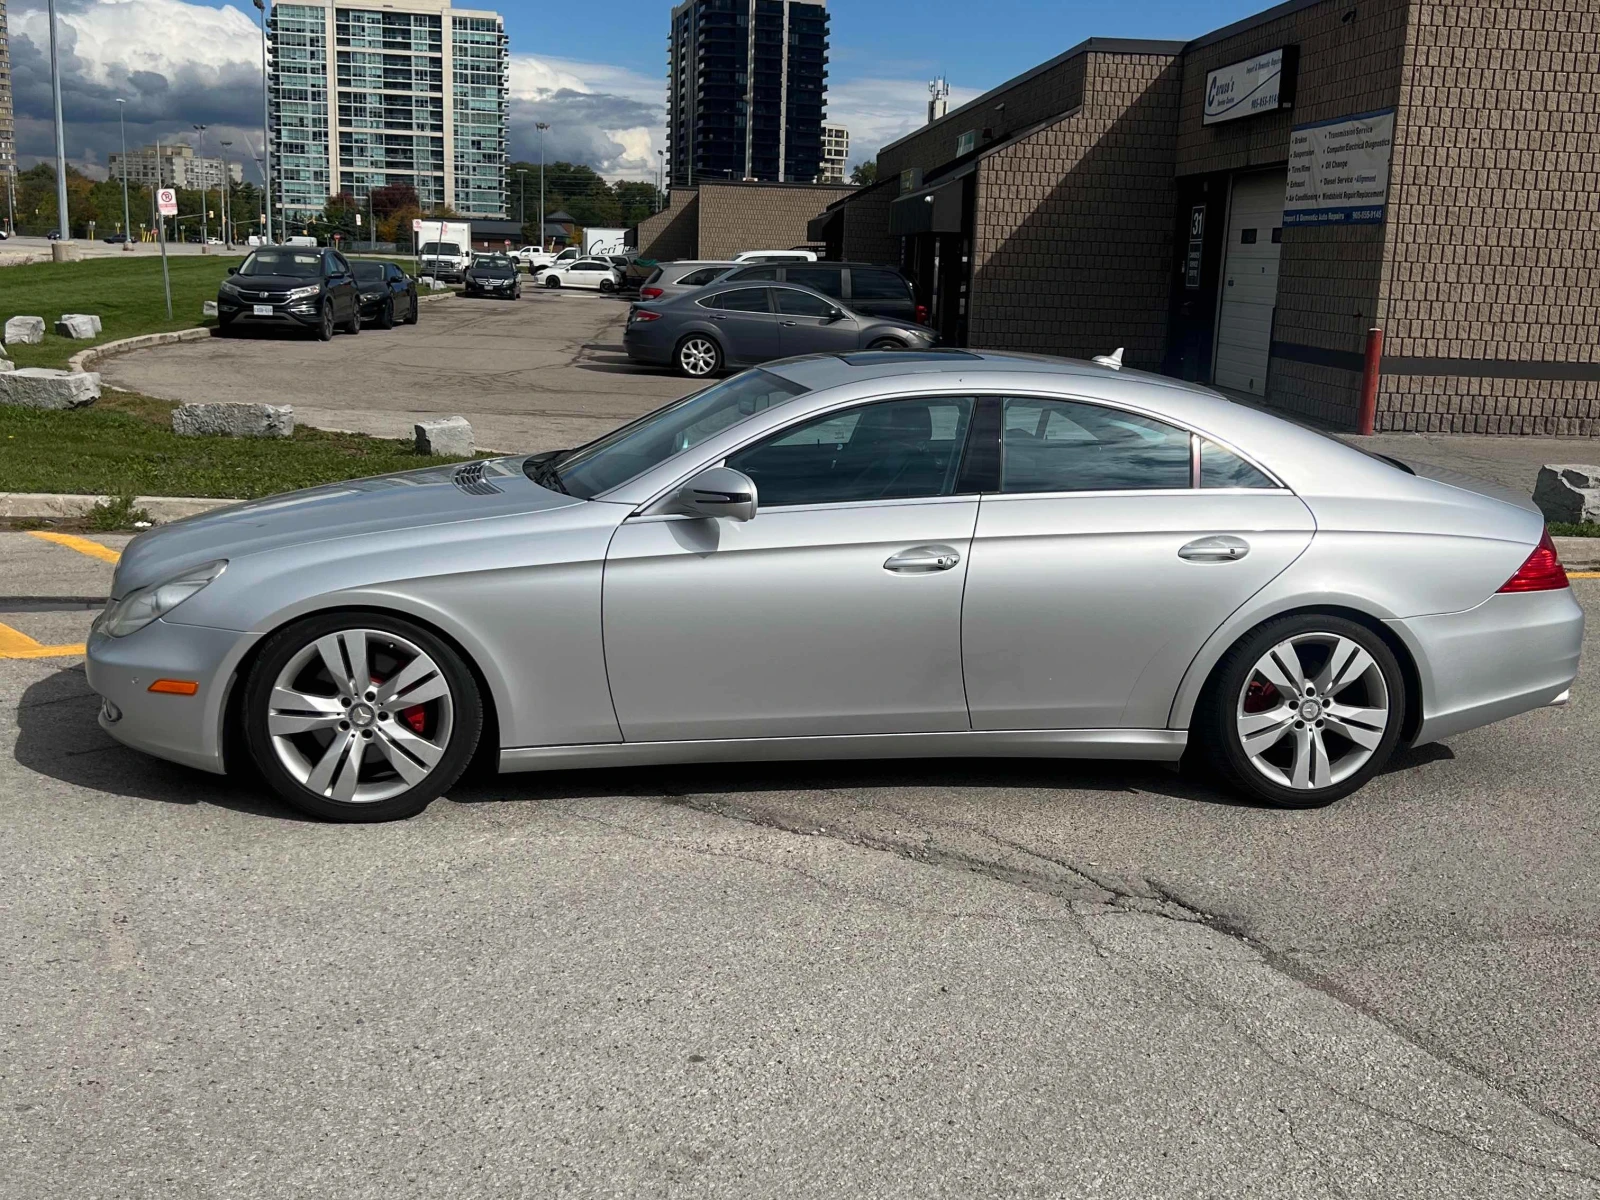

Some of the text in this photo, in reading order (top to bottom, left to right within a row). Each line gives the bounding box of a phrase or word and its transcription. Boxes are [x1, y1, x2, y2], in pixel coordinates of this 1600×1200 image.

[1208, 76, 1234, 107] Caruso's
[1328, 126, 1373, 139] Transmission Service
[1294, 136, 1307, 144] Brakes
[1327, 138, 1390, 156] Computer Electrical Diagnostics
[1293, 150, 1314, 160] Suspension
[1332, 160, 1348, 169] Change
[1290, 180, 1305, 188] Exhaust
[1324, 176, 1353, 186] Diesel Service
[1356, 175, 1376, 184] Alignment
[1295, 193, 1318, 204] Conditioning
[1322, 189, 1384, 201] Windshield Repair Replacement
[1300, 213, 1318, 221] Domestic
[1328, 212, 1344, 221] Repairs
[1193, 212, 1202, 235] 31
[588, 239, 616, 255] Ceri
